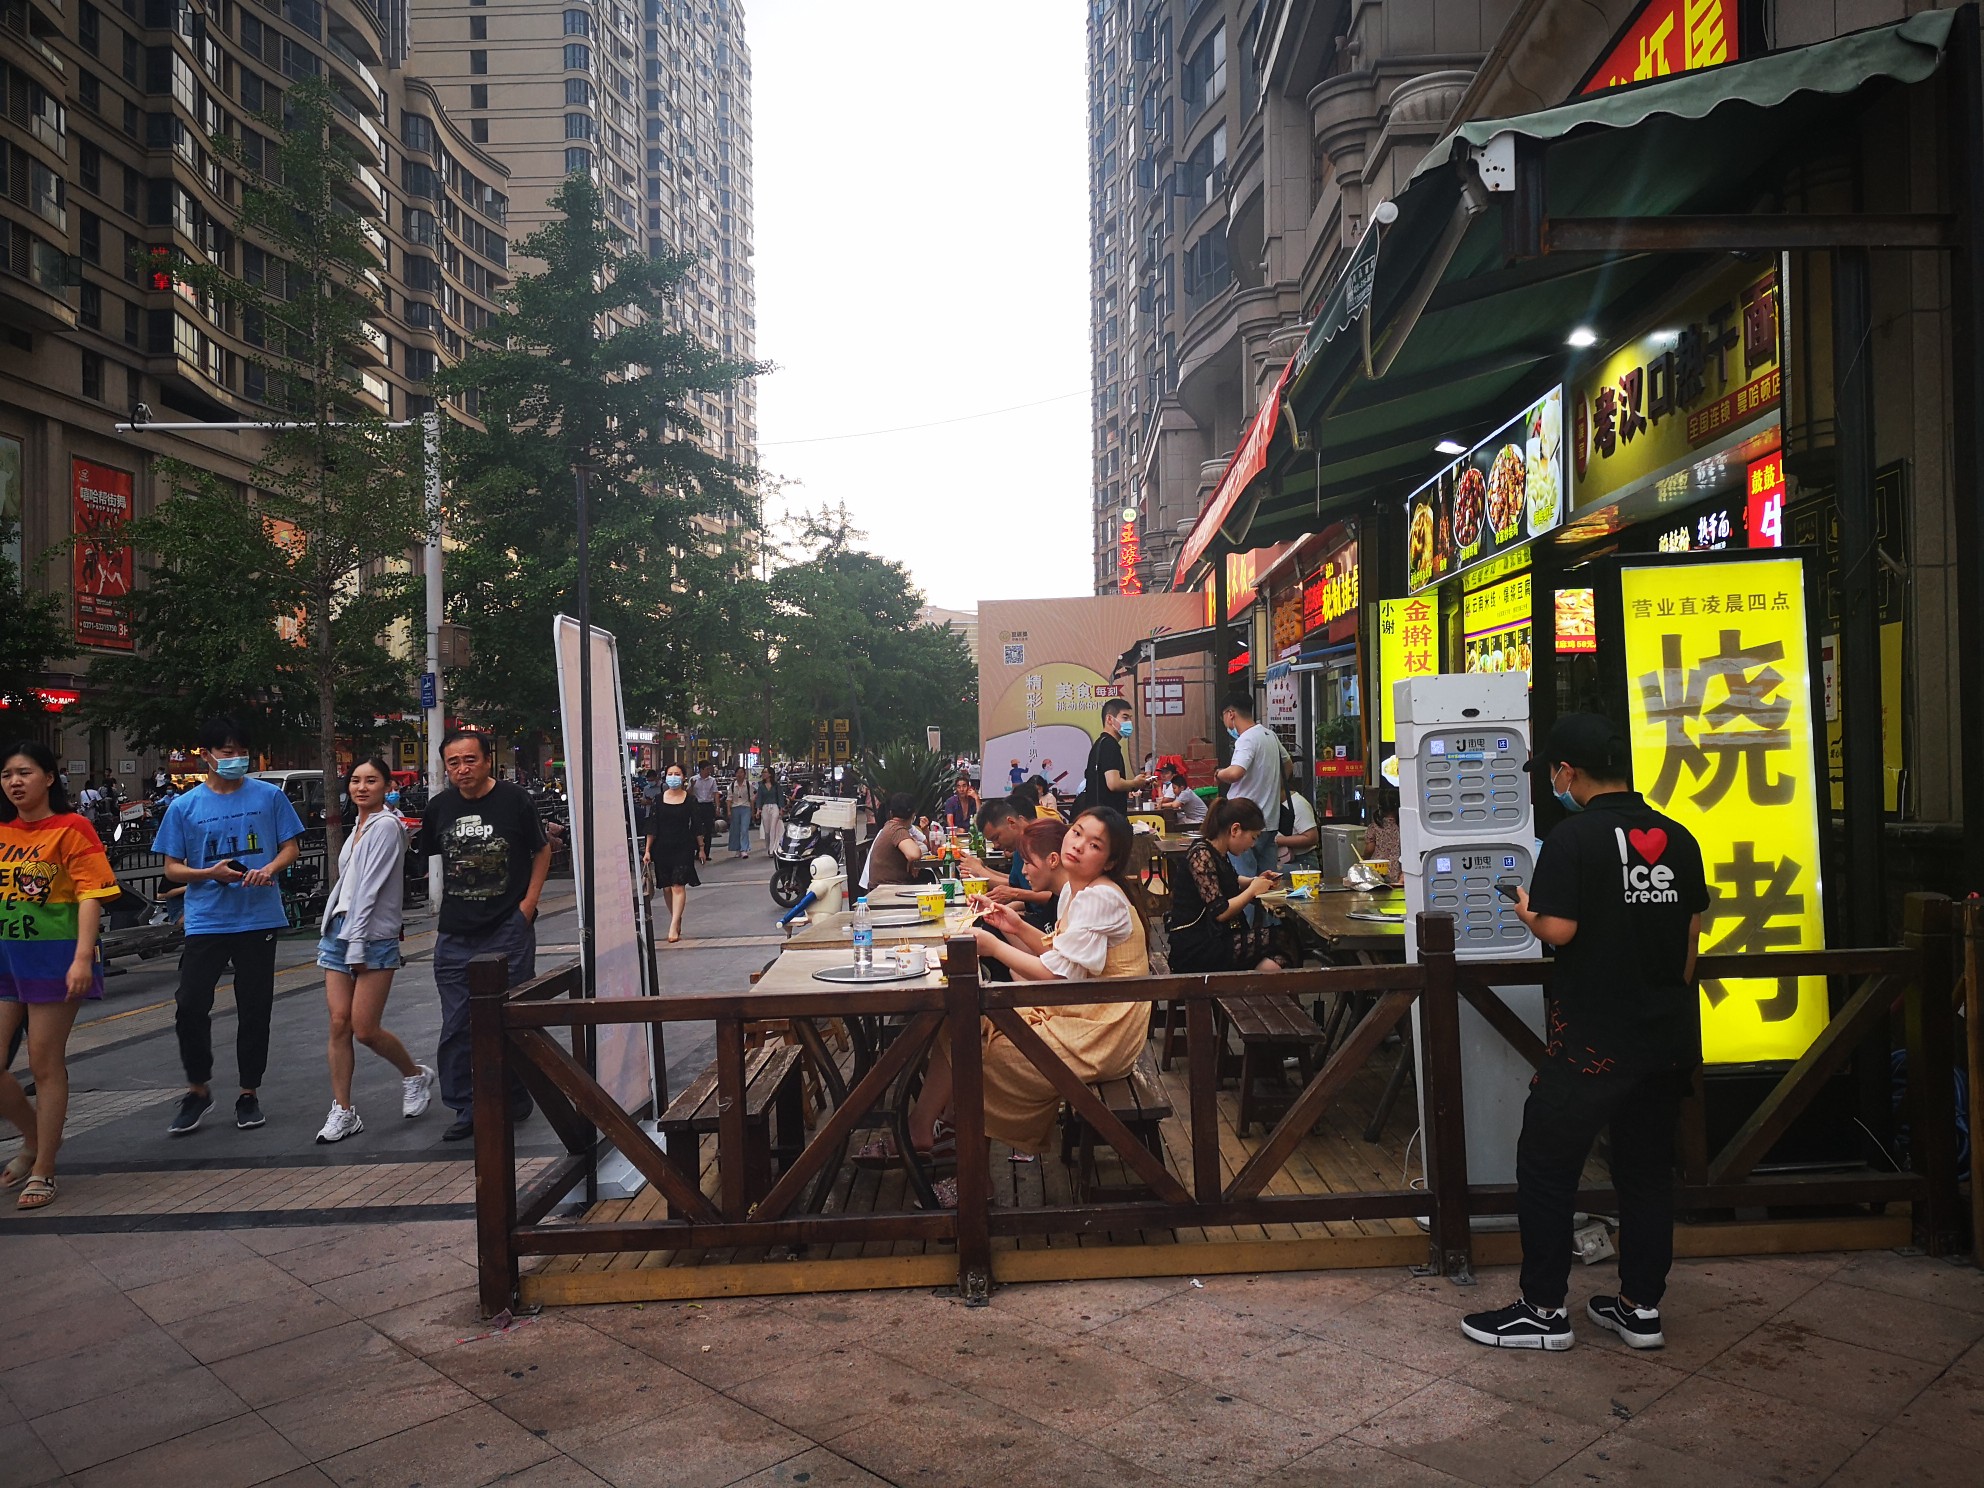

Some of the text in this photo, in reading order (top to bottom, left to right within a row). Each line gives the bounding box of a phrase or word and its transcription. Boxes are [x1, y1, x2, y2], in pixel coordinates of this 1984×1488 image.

[1594, 272, 1778, 459] 老汉口热干面
[1689, 400, 1731, 438] 全国连锁
[1120, 522, 1142, 596] 王婆大
[1382, 602, 1395, 634] 小谢
[1632, 591, 1791, 618] 营业直凌晨四点
[1056, 682, 1094, 700] 美食
[1096, 687, 1118, 697] 每刻
[456, 824, 493, 838] Jeep
[1614, 827, 1628, 864] I
[1623, 864, 1675, 890] ice
[1624, 889, 1678, 904] cream
